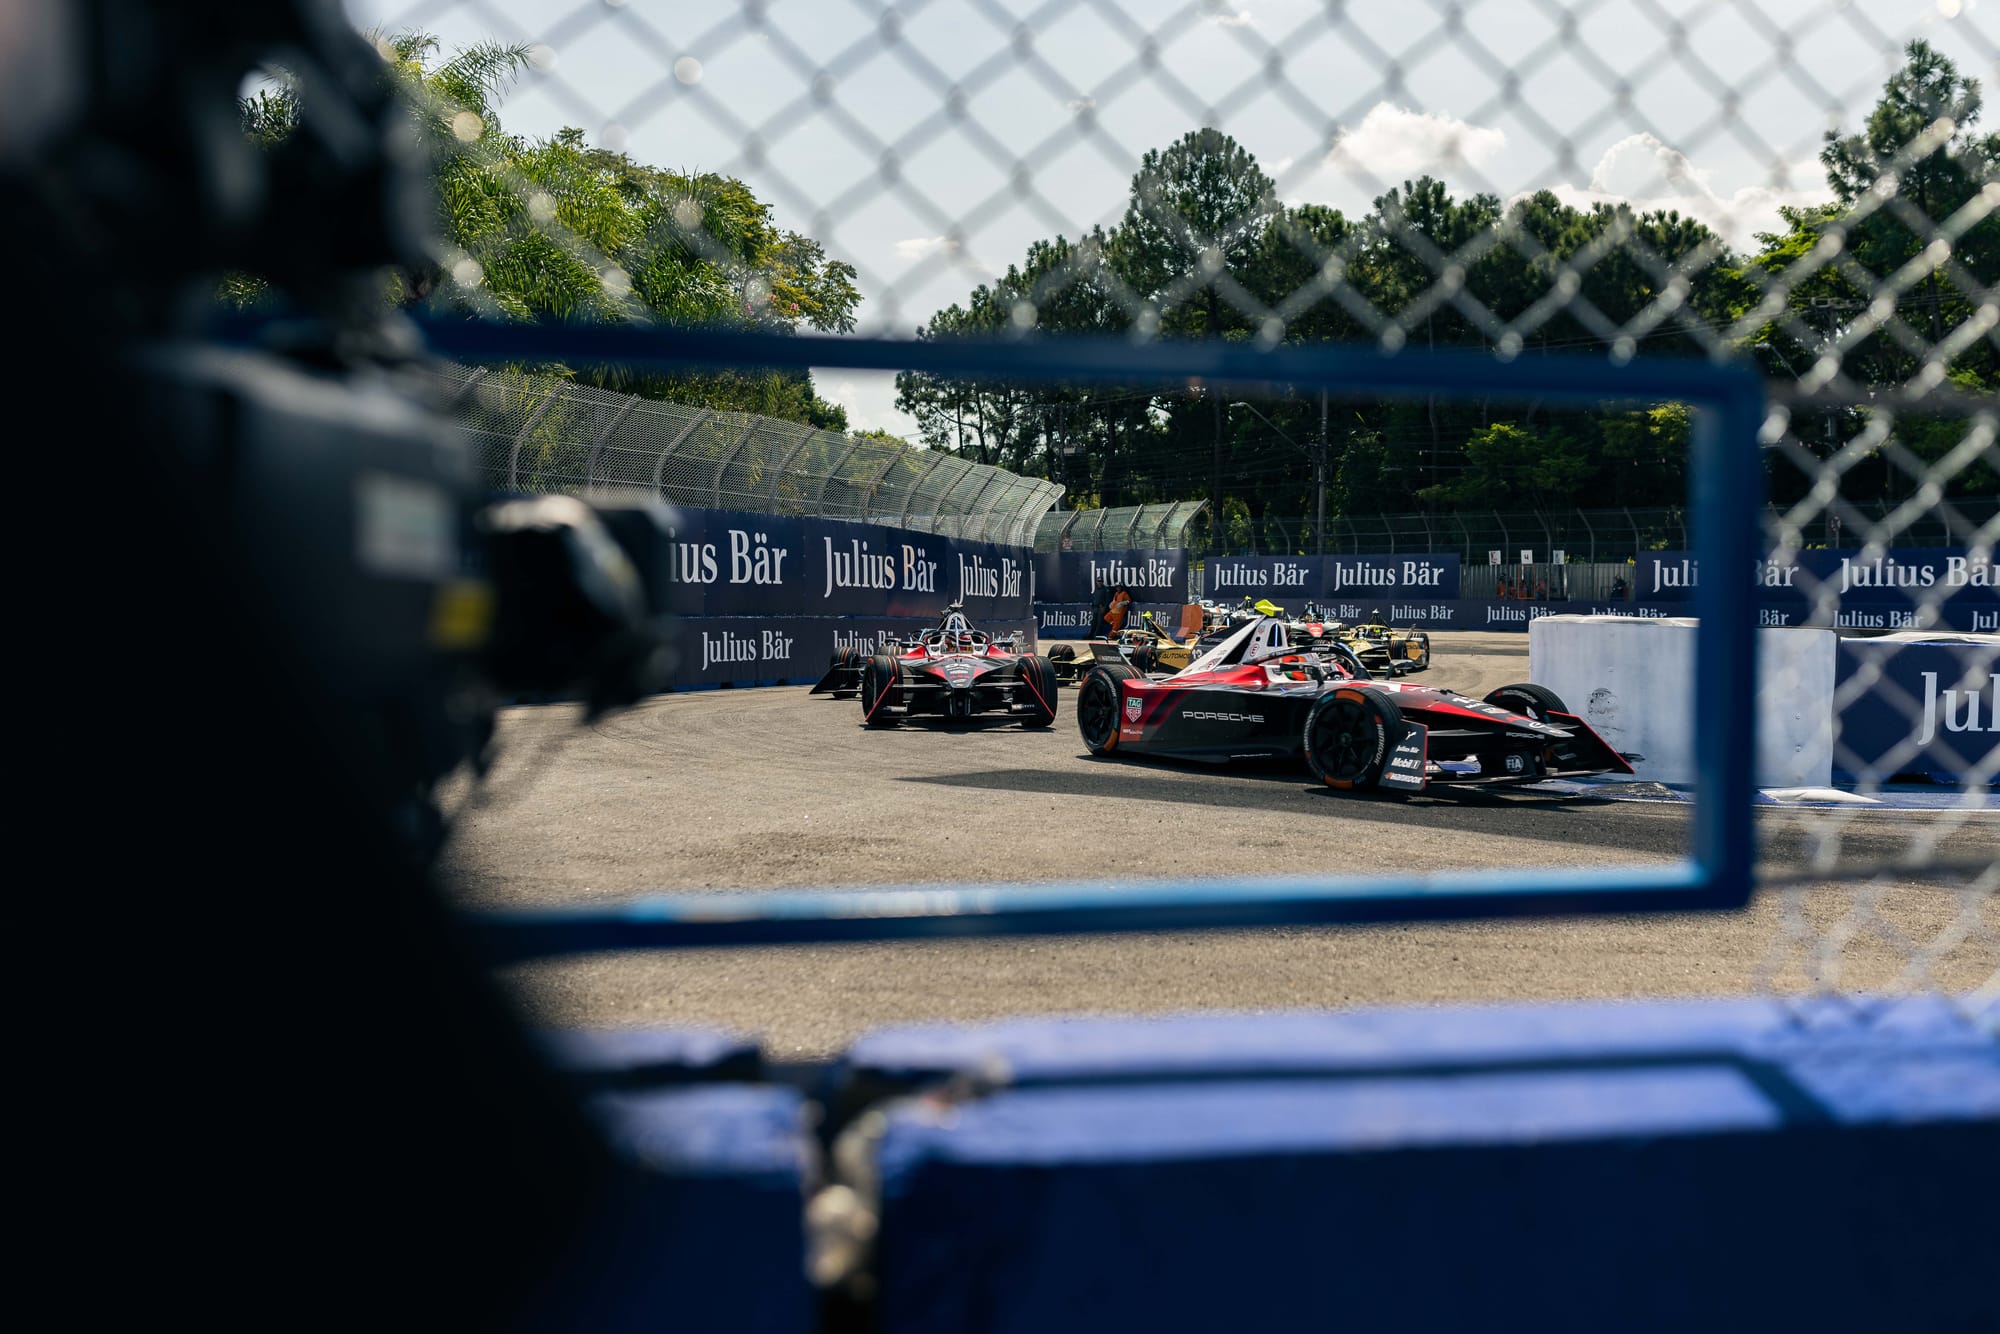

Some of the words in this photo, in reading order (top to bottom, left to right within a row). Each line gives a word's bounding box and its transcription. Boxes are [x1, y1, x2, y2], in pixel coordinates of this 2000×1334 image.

[668, 527, 718, 583] ius
[728, 529, 787, 585] Bär
[824, 536, 895, 598] Julius
[901, 544, 937, 593] Bär
[959, 553, 998, 605] Julius
[1001, 558, 1022, 599] Bär
[1090, 559, 1146, 594] Julius
[1149, 558, 1176, 588] Bär
[1214, 563, 1267, 591] Julius
[1272, 562, 1309, 586] Bär
[1334, 562, 1395, 591] Julius
[1402, 561, 1444, 586] Bär
[1653, 559, 1700, 593] Juli
[1840, 558, 1935, 594] Julius
[1041, 610, 1077, 629] Julius
[1304, 604, 1337, 618] lius
[1340, 604, 1362, 619] Bär
[1391, 605, 1427, 621] Julius
[1430, 604, 1454, 620] Bär
[1487, 606, 1526, 624] Julius
[1759, 609, 1790, 626] Bär
[1833, 611, 1884, 629] Julius
[1889, 611, 1924, 628] Bär
[1972, 611, 1999, 632] Jul
[702, 631, 757, 671] Julius
[761, 630, 794, 660] Bär
[1128, 699, 1141, 707] TAG
[1182, 711, 1265, 723] PORSCHE
[1917, 671, 2000, 746] Jul
